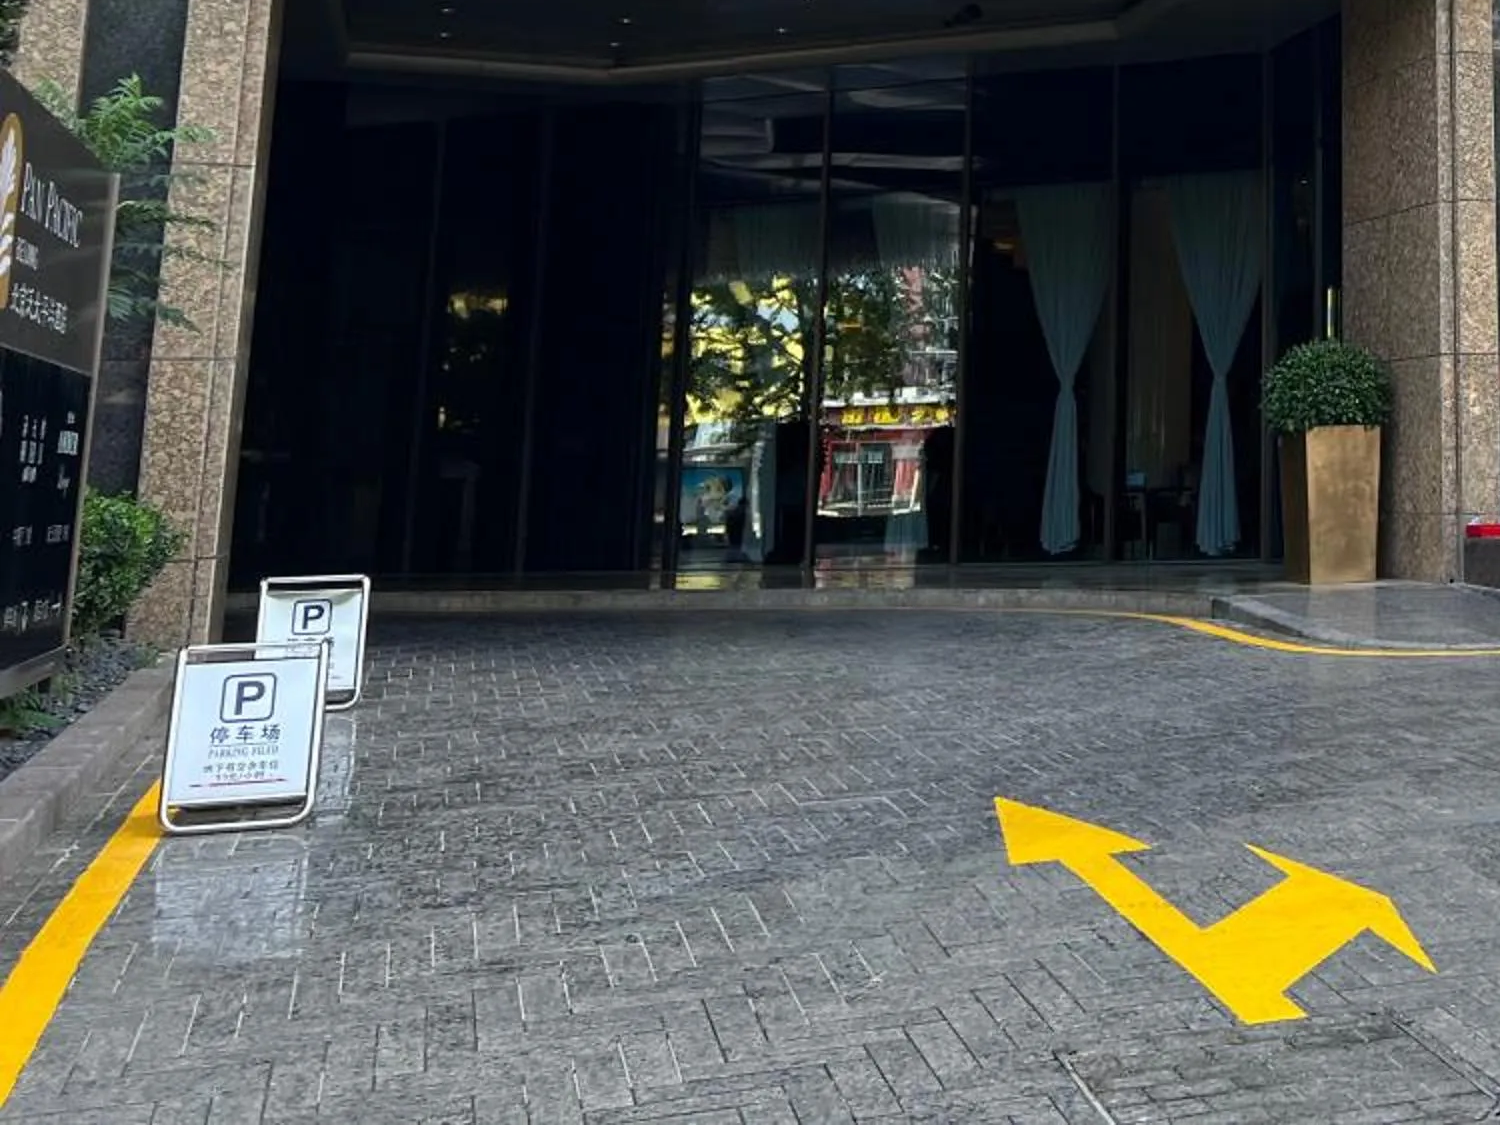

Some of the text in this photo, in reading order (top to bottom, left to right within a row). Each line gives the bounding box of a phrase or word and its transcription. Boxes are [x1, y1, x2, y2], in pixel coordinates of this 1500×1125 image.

[21, 161, 83, 249] PAN PACIFIC
[302, 604, 325, 629] P
[233, 680, 266, 716] P
[209, 723, 281, 744] 停车场
